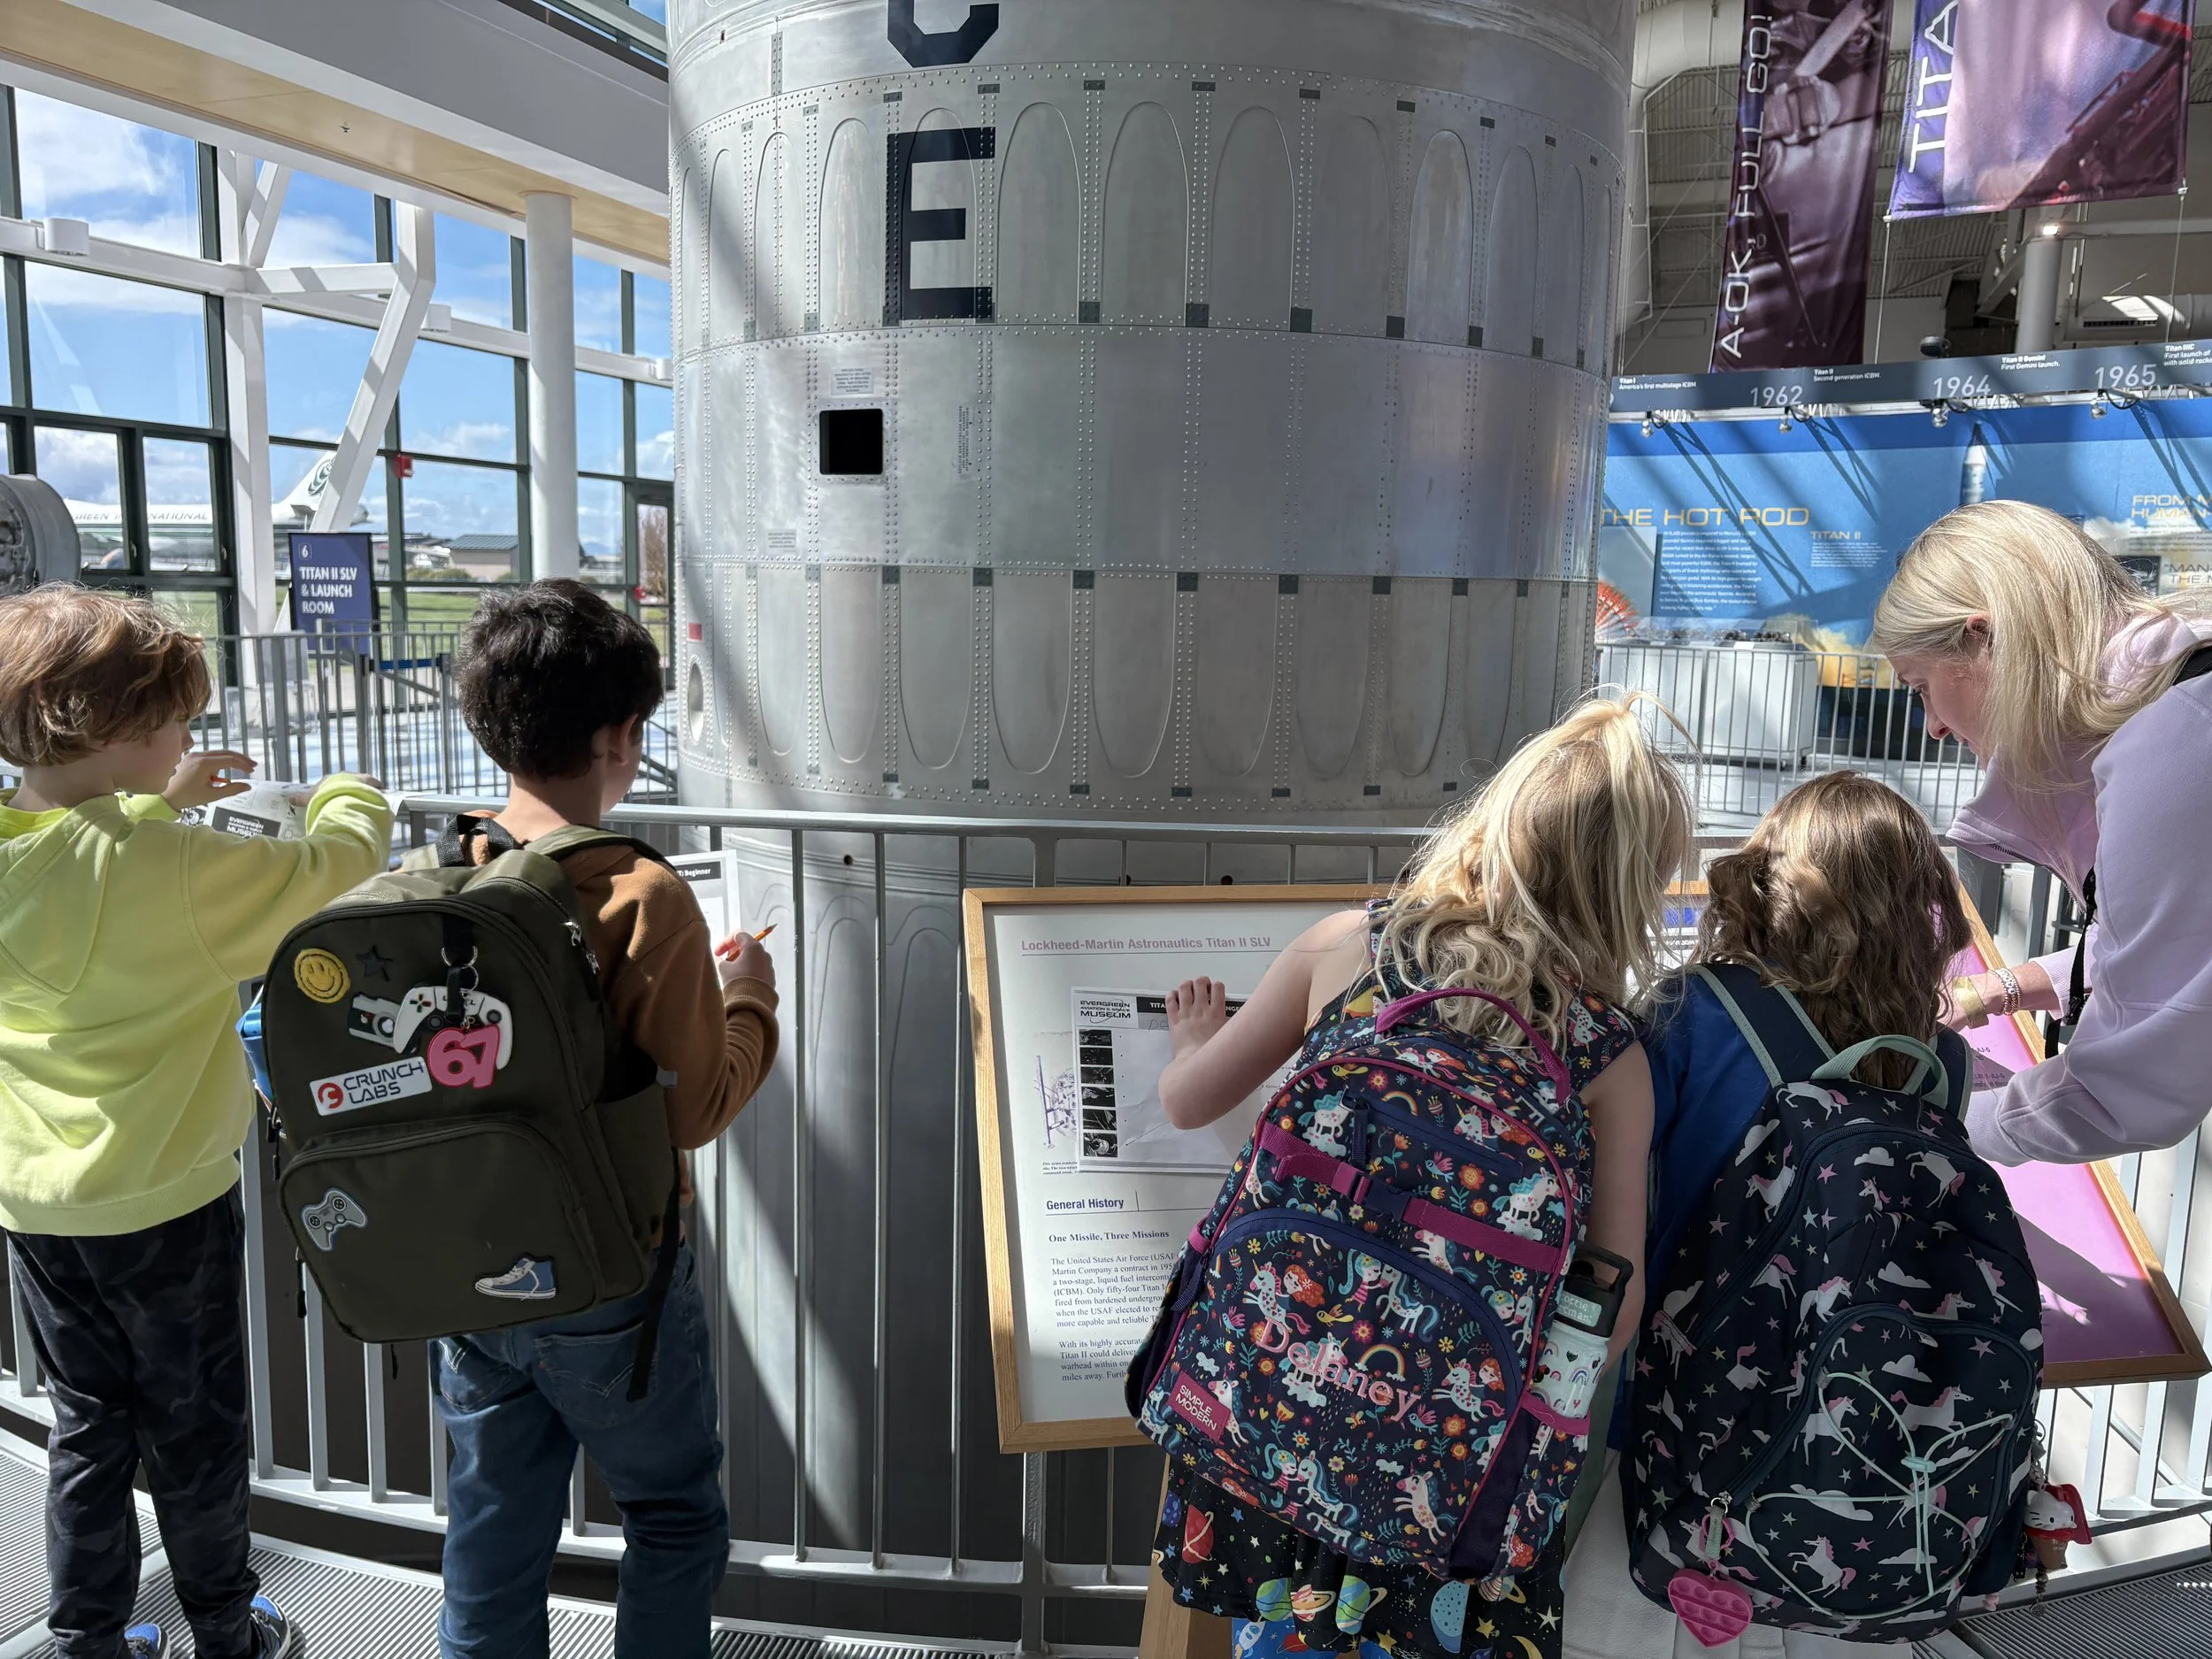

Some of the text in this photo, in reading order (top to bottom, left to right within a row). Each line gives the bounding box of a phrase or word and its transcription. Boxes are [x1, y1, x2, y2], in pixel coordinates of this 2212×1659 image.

[1747, 14, 1773, 94] GO!
[1908, 0, 1958, 173] TITA
[1735, 111, 1764, 218] FULL
[1720, 237, 1756, 358] A-OK,
[2095, 364, 2156, 389] 1965
[1933, 374, 1991, 398] 1964
[1750, 385, 1803, 407] 1962
[2131, 495, 2191, 507] FROM
[1601, 507, 1809, 526] THE HOT ROD
[1810, 530, 1862, 540] TITAN II
[302, 545, 309, 558] 6
[299, 566, 357, 581] TITAN II SLV
[2164, 564, 2212, 572] "MAN-
[2170, 573, 2201, 584] THE
[301, 583, 353, 598] & LAUNCH
[302, 601, 334, 614] ROOM
[1021, 937, 1271, 952] Lockheed-Martin Astronautics Titan II SLV
[426, 1023, 501, 1089] 67
[343, 1062, 425, 1091] CRUNCH
[349, 1081, 401, 1105] LABS
[1047, 1198, 1125, 1210] General History
[1070, 1233, 1103, 1241] Missile,
[1132, 1230, 1170, 1239] Missions
[1067, 1256, 1091, 1265] United
[1078, 1266, 1112, 1276] Company
[1059, 1278, 1096, 1286] two-stage,
[1087, 1287, 1105, 1296] Only
[1106, 1286, 1140, 1294] fifty-four
[1094, 1296, 1127, 1305] hardened
[1090, 1307, 1114, 1316] USAF
[1115, 1305, 1141, 1314] elected
[1077, 1318, 1105, 1327] capable
[1089, 1339, 1113, 1348] highly
[1061, 1362, 1093, 1371] warhead
[1094, 1360, 1118, 1369] within
[1255, 1317, 1421, 1422] Delaney
[1179, 1385, 1212, 1417] SIMPLE
[1176, 1394, 1217, 1431] MODERN
